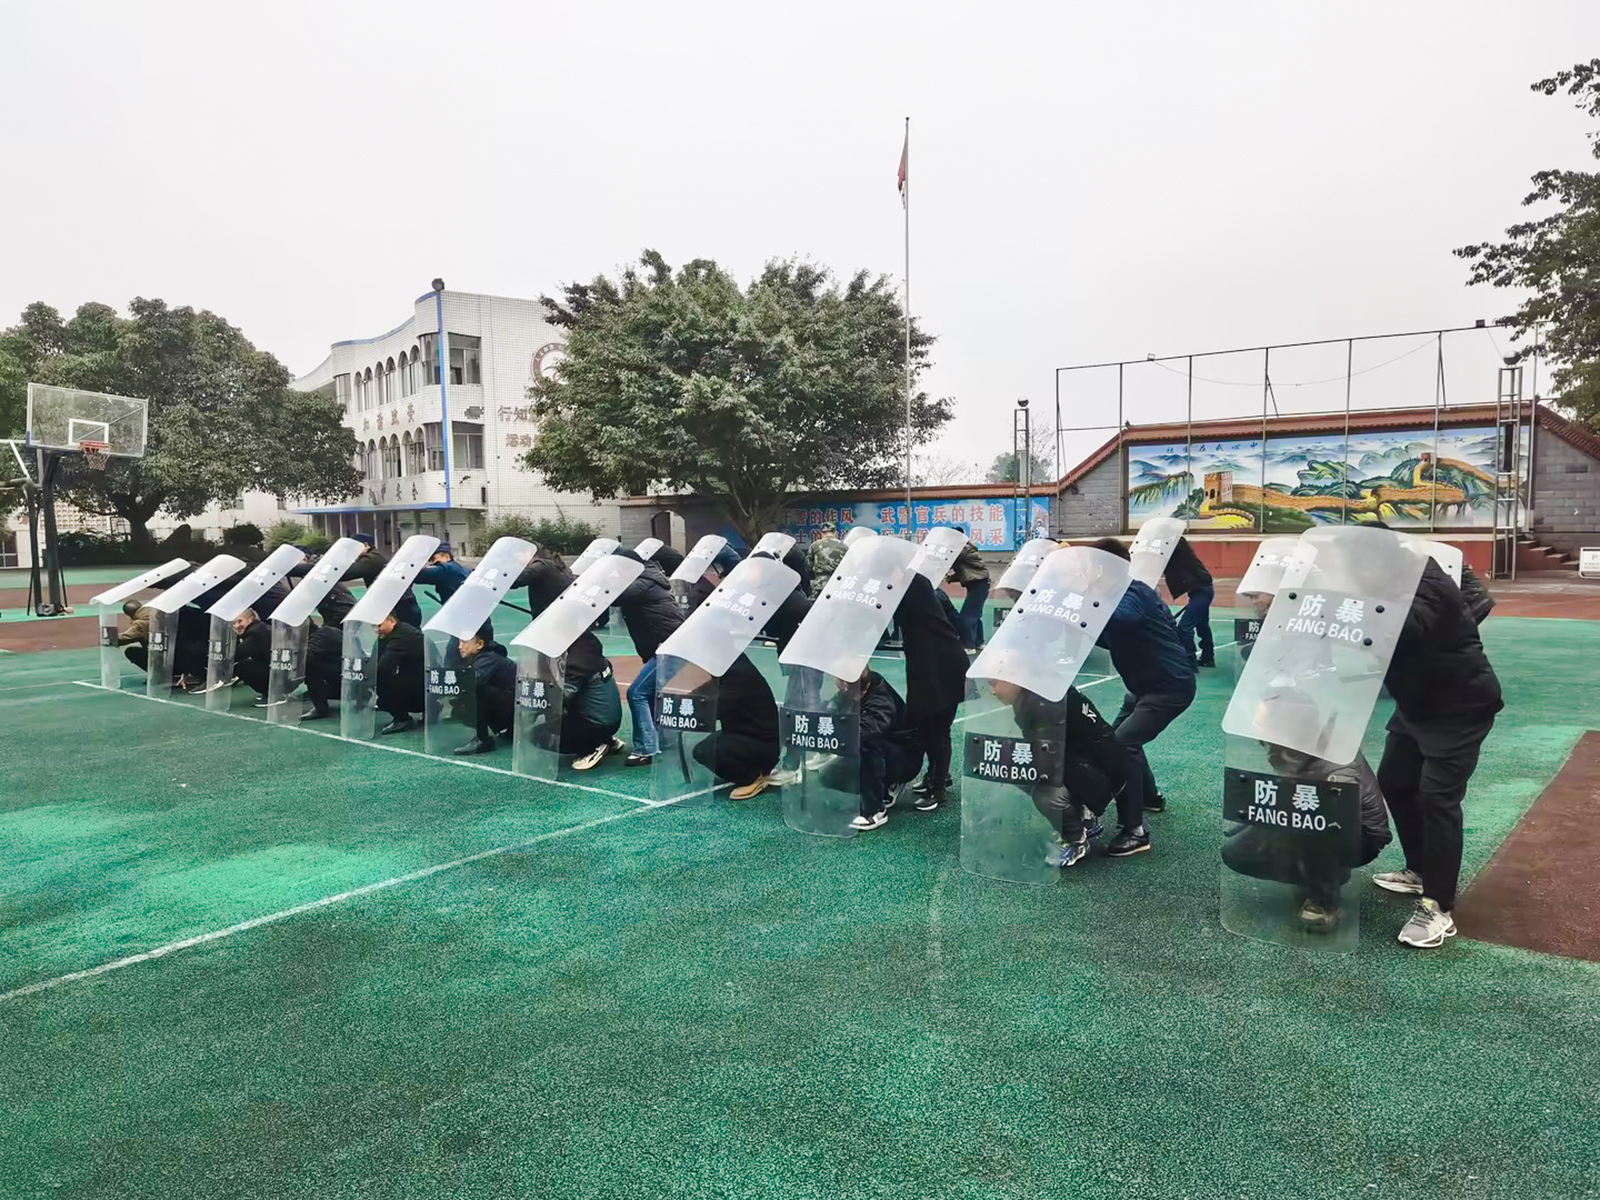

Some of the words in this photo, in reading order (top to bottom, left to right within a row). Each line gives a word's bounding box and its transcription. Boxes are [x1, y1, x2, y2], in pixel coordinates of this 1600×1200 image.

[880, 504, 1004, 524] 武警官兵的技能
[855, 593, 878, 607] BAO
[1034, 588, 1084, 611] 防暴
[731, 602, 750, 617] BAO
[1024, 603, 1055, 615] FANG
[1054, 607, 1080, 623] BAO
[1298, 594, 1365, 625] 防暴
[1285, 618, 1327, 636] FANG
[1327, 623, 1364, 643] BAO
[430, 669, 457, 685] 防暴
[443, 685, 460, 695] BAO
[532, 699, 547, 709] BAO
[662, 697, 695, 716] 防暴
[660, 714, 677, 727] FANG
[678, 717, 697, 729] BAO
[795, 714, 835, 736] 防暴
[791, 733, 815, 748] FANG
[817, 737, 839, 750] BAO
[983, 740, 1033, 765] 防暴
[979, 762, 1009, 779] FANG
[1011, 766, 1038, 781] BAO
[1254, 779, 1320, 812] 防暴
[1248, 805, 1288, 827] FANG
[1292, 812, 1326, 831] BAO
